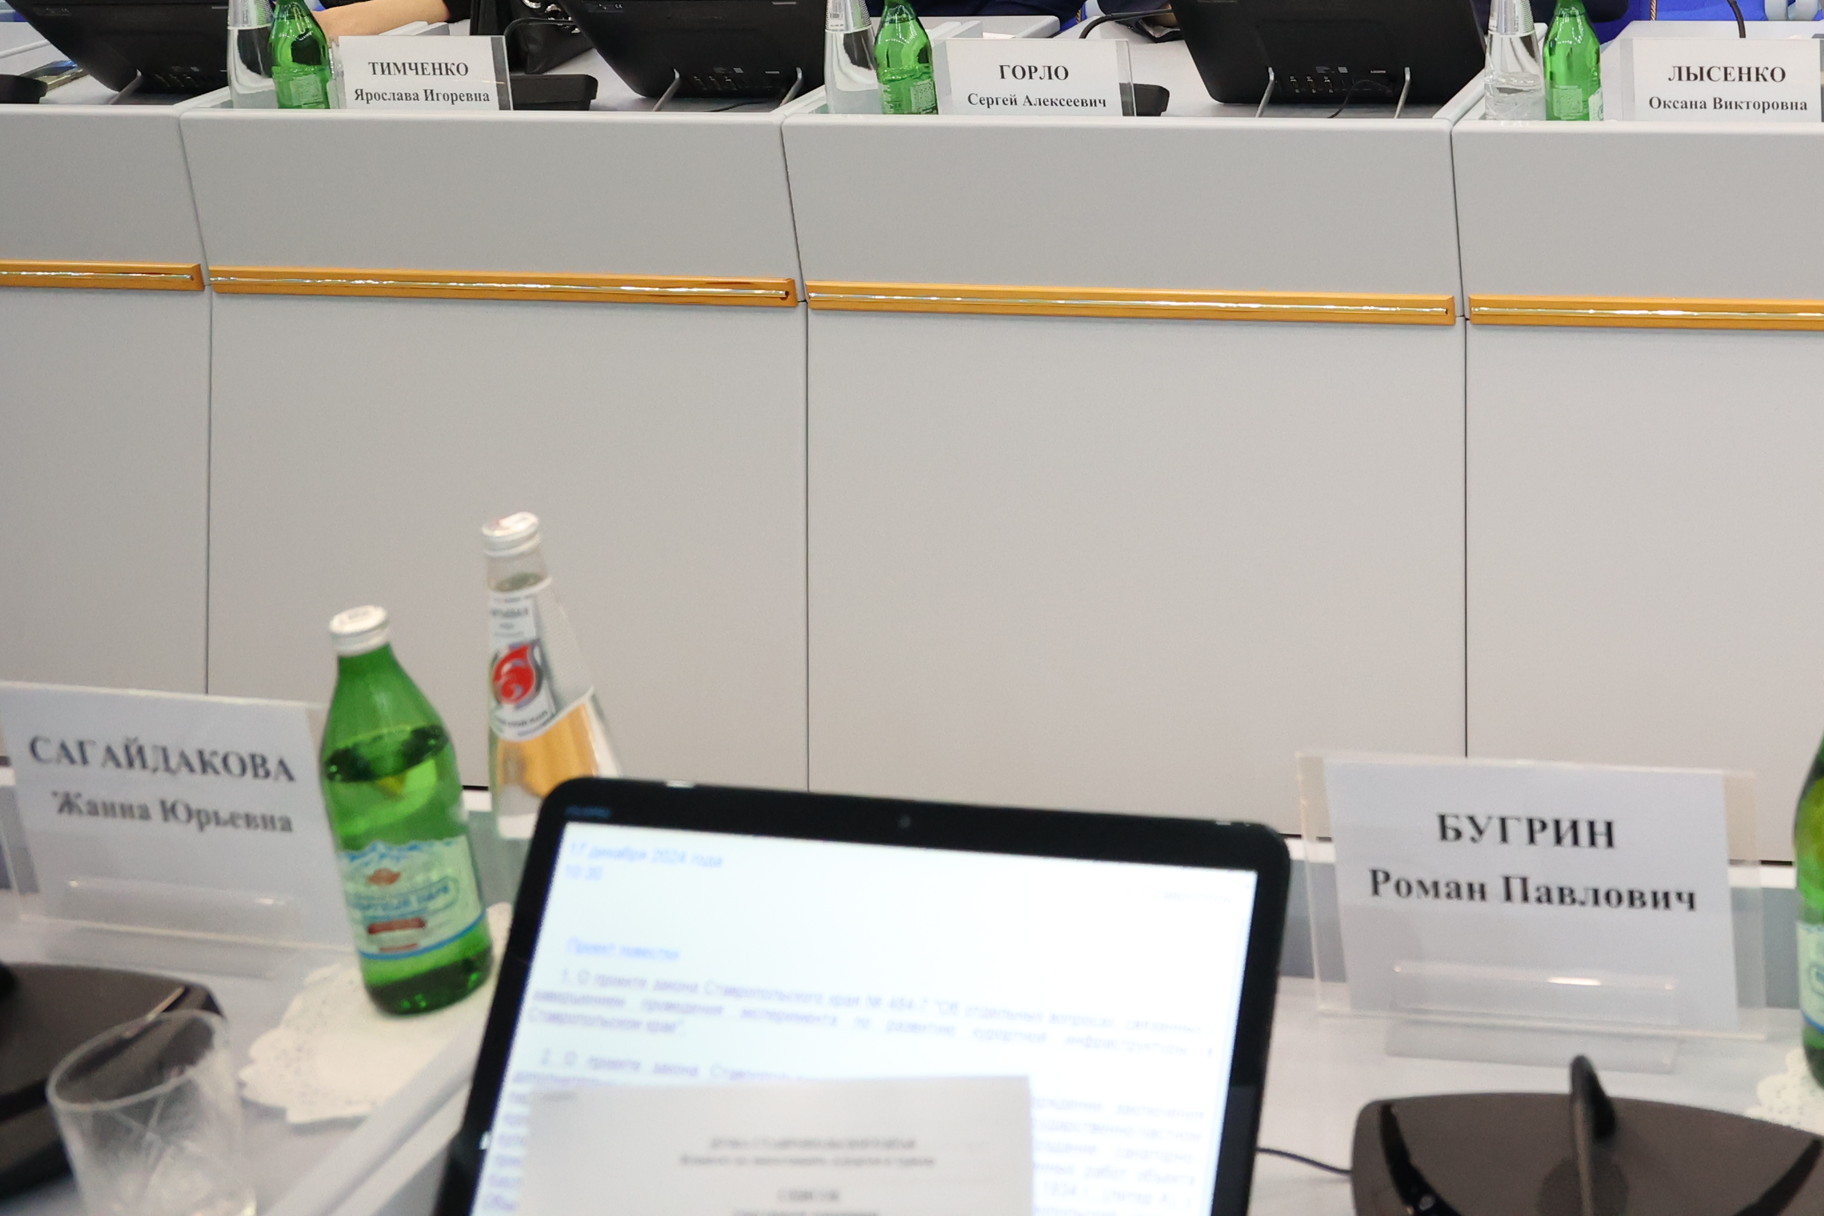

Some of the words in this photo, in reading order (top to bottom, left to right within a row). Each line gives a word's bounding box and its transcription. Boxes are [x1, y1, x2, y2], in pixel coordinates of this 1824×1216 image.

[367, 60, 470, 77] ТИМЧЕНКО
[998, 63, 1070, 83] ГОРЛО
[1667, 64, 1788, 85] ЛЫСЕНКО
[354, 87, 421, 105] Ярослава
[423, 87, 491, 106] Игоревна
[966, 91, 1019, 110] Сергей
[1022, 92, 1108, 109] Алексеевич
[1647, 95, 1708, 112] Оксана
[1711, 95, 1809, 115] Викторовна
[27, 733, 297, 784] САГАЙДАКОВА
[51, 789, 154, 822] Жанна
[158, 796, 295, 835] Юрьевна
[1436, 812, 1616, 850] БУГРИН
[1367, 867, 1489, 903] Роман
[1500, 873, 1699, 913] Павлович
